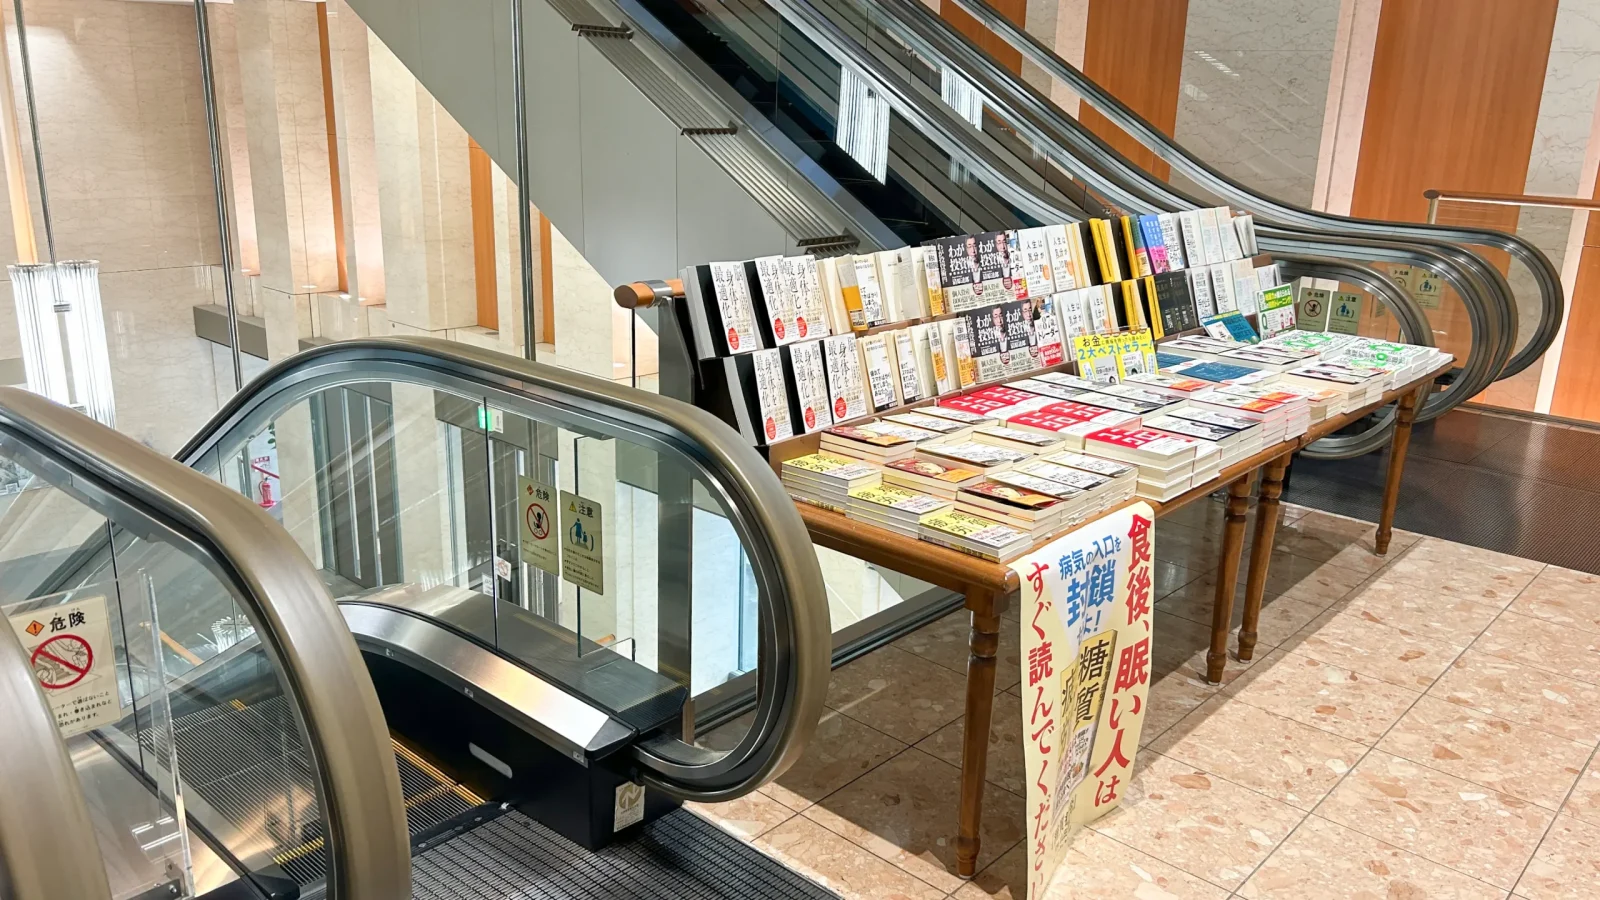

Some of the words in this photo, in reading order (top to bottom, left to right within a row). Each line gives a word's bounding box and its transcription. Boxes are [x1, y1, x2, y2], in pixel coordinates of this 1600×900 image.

[948, 243, 965, 258] わが
[979, 240, 995, 254] わが
[1026, 240, 1043, 250] 人生は
[1027, 252, 1045, 265] 気分が
[714, 265, 733, 320] 最適化
[725, 269, 740, 318] 身体を
[760, 260, 779, 311] 最適化
[976, 314, 992, 328] わが
[1006, 308, 1021, 323] わが
[756, 355, 771, 408] 最適化
[794, 348, 810, 400] 最適化
[828, 341, 842, 391] 最適化
[839, 342, 850, 388] 身体を
[535, 487, 550, 502] 危険
[578, 503, 594, 518] 注意
[1058, 534, 1122, 580] 病気の入口を
[1066, 559, 1116, 628] 封鎖
[49, 611, 86, 633] 危険
[1078, 639, 1110, 722] 糖質
[1094, 514, 1152, 807] 食後、眠い人は
[52, 691, 109, 710] ーターで遊ばないこと
[1026, 561, 1055, 900] すぐ読んでください
